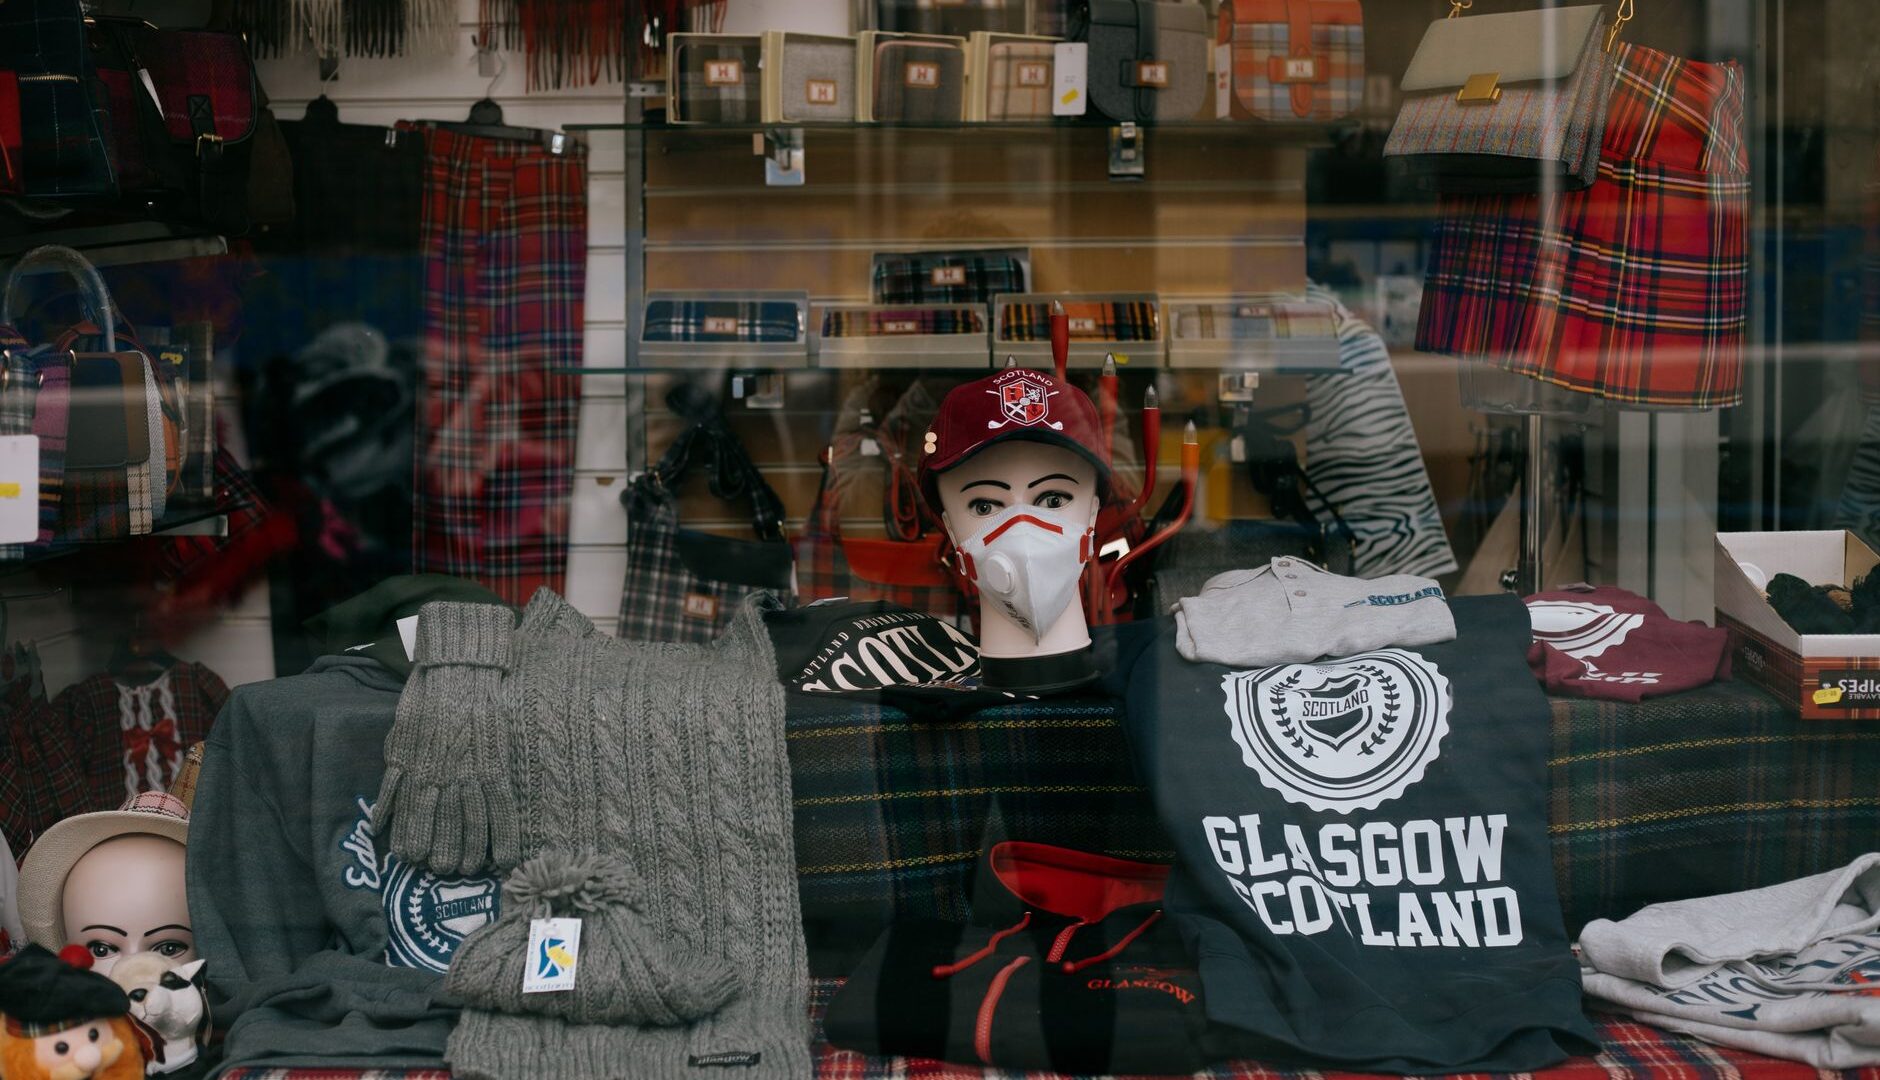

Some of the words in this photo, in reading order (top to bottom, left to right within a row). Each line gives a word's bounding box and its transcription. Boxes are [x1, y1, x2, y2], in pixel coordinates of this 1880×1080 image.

[993, 370, 1053, 387] SCOTLAND
[1367, 586, 1442, 606] SCOTLAND
[1302, 689, 1369, 717] SCOTLAND
[1202, 813, 1508, 887] GLASGOW
[1087, 978, 1195, 1005] GLASGOW
